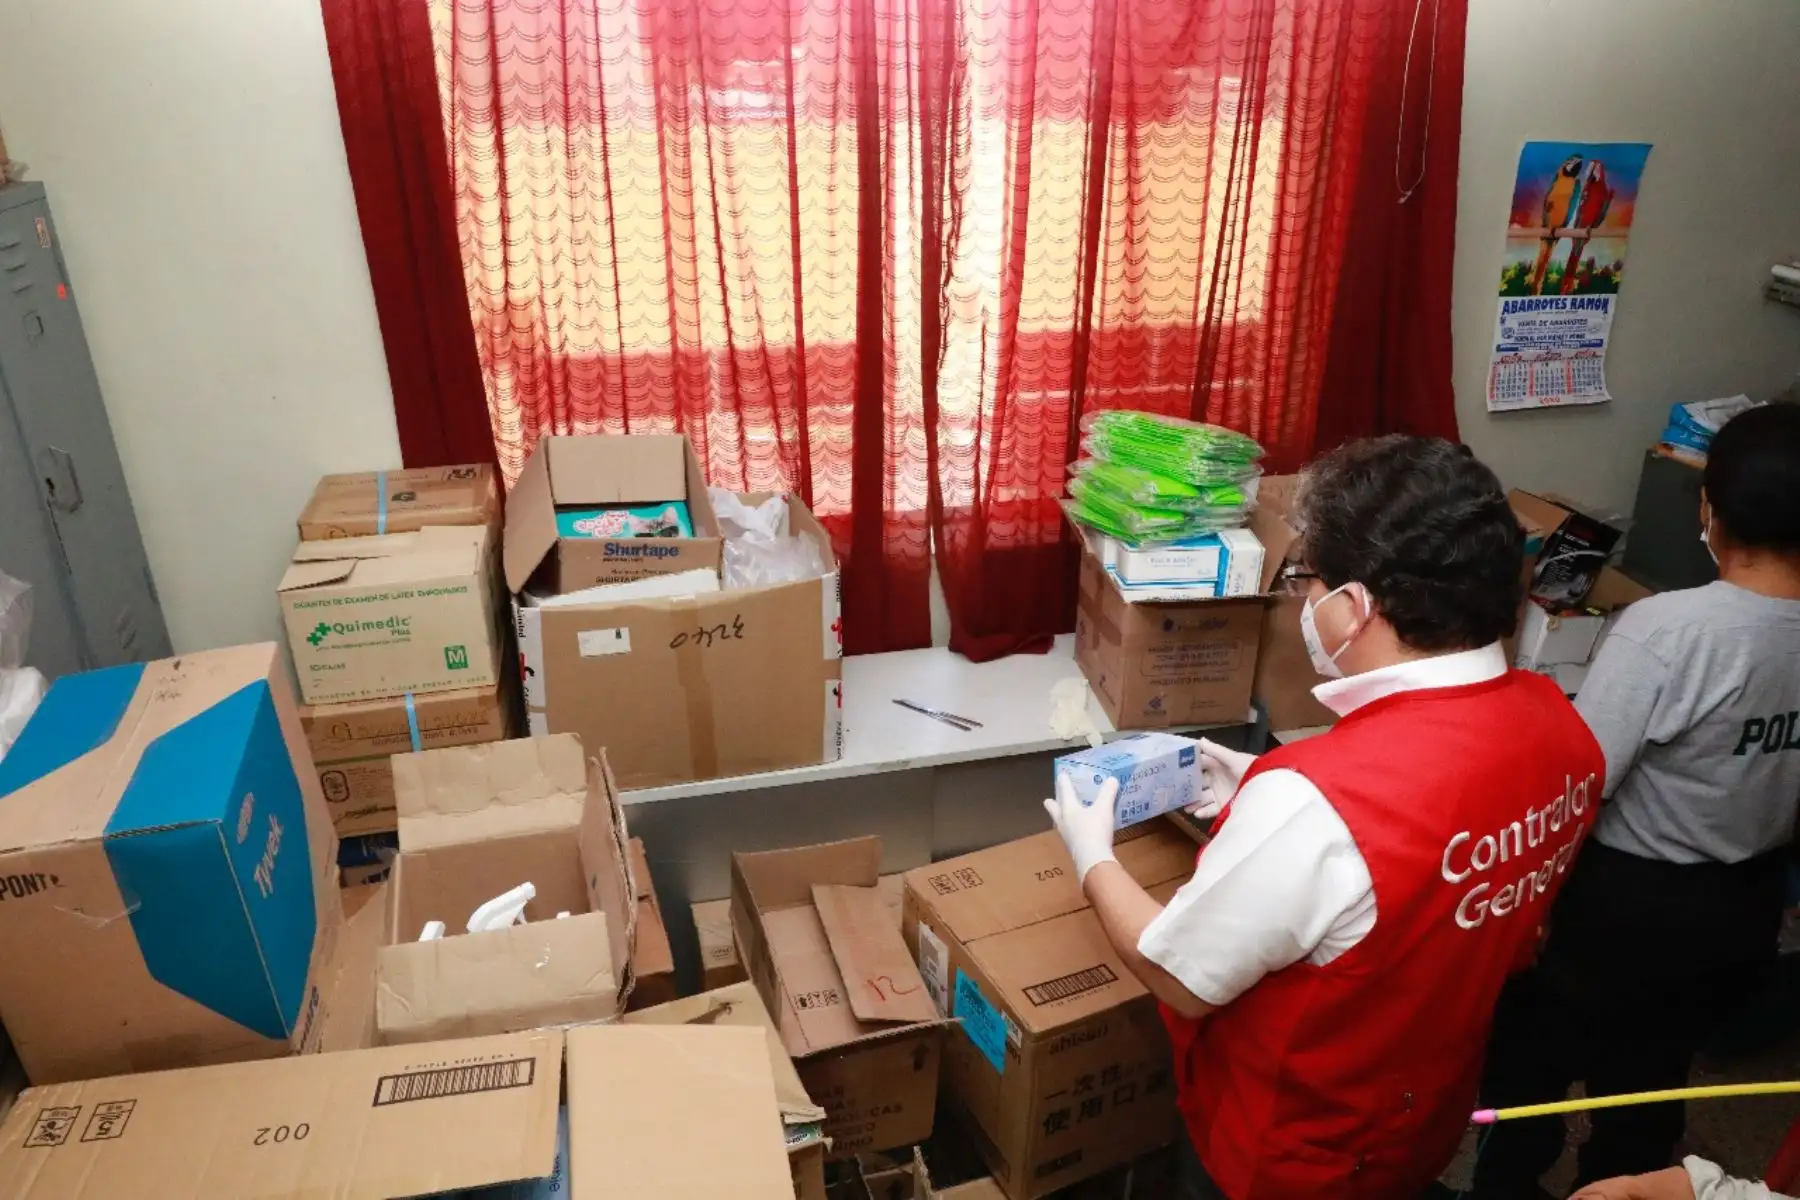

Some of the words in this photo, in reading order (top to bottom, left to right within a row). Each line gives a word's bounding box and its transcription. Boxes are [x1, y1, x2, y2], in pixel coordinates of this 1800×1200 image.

[1502, 298, 1567, 315] ABARROTES
[603, 542, 680, 560] Shurtape
[333, 616, 410, 635] Quimedic
[448, 650, 465, 664] M
[1732, 711, 1800, 756] POL
[1441, 772, 1596, 884] Contralor
[1455, 822, 1585, 930] General
[253, 1122, 310, 1146] 002
